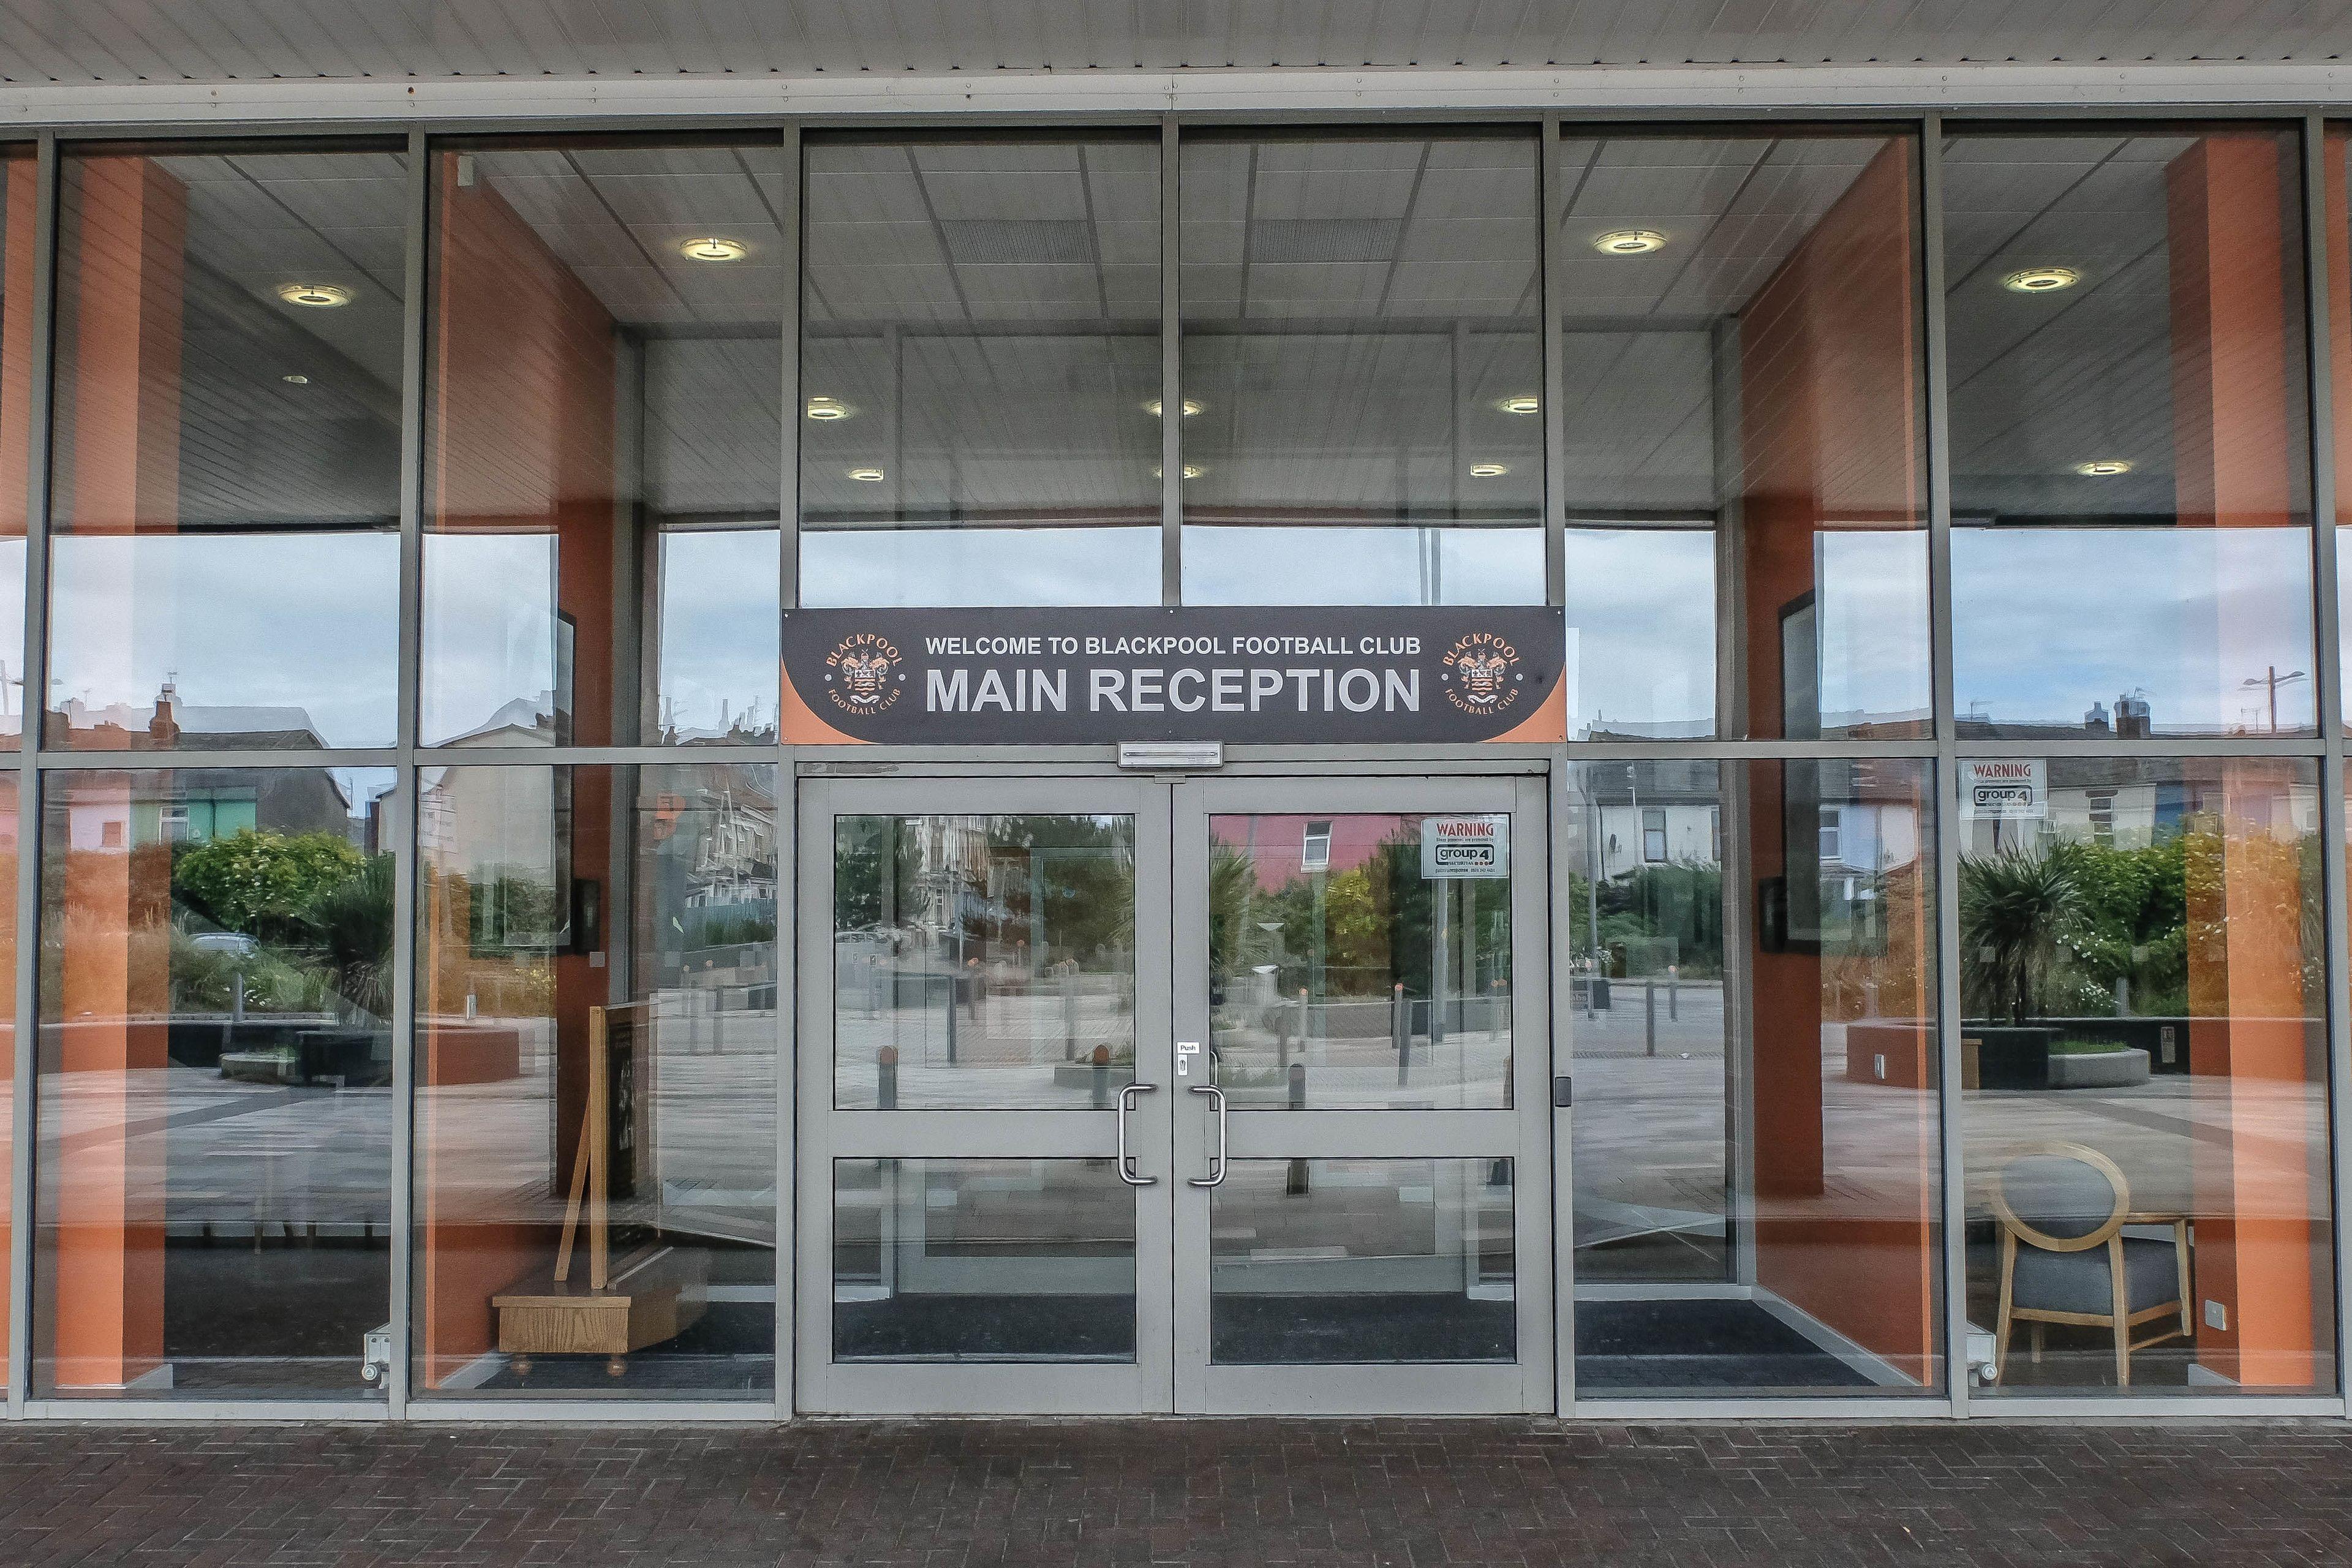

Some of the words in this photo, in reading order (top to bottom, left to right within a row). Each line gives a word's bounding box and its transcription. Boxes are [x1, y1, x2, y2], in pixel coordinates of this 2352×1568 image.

[826, 633, 903, 667] BLACKPOOL
[925, 636, 1041, 655] WELCOME
[1047, 636, 1078, 655] TO
[1085, 636, 1226, 655] BLACKPOOL
[1232, 636, 1354, 655] FOOTBALL
[1359, 636, 1421, 655] CLUB
[1442, 633, 1520, 666] BLACKPOOL
[828, 688, 876, 715] FOOTBALL
[879, 688, 901, 710] CLUB
[926, 669, 1067, 712] MAIN
[1090, 668, 1420, 713] RECEPTION
[1445, 688, 1494, 715] FOOTBALL
[1497, 688, 1518, 710] CLUB
[1973, 763, 2031, 778] WARNING
[1977, 790, 2016, 801] group
[2018, 790, 2027, 801] 4
[1436, 823, 1494, 837] WARNING
[1440, 849, 1478, 861] group
[1479, 849, 1490, 860] 4
